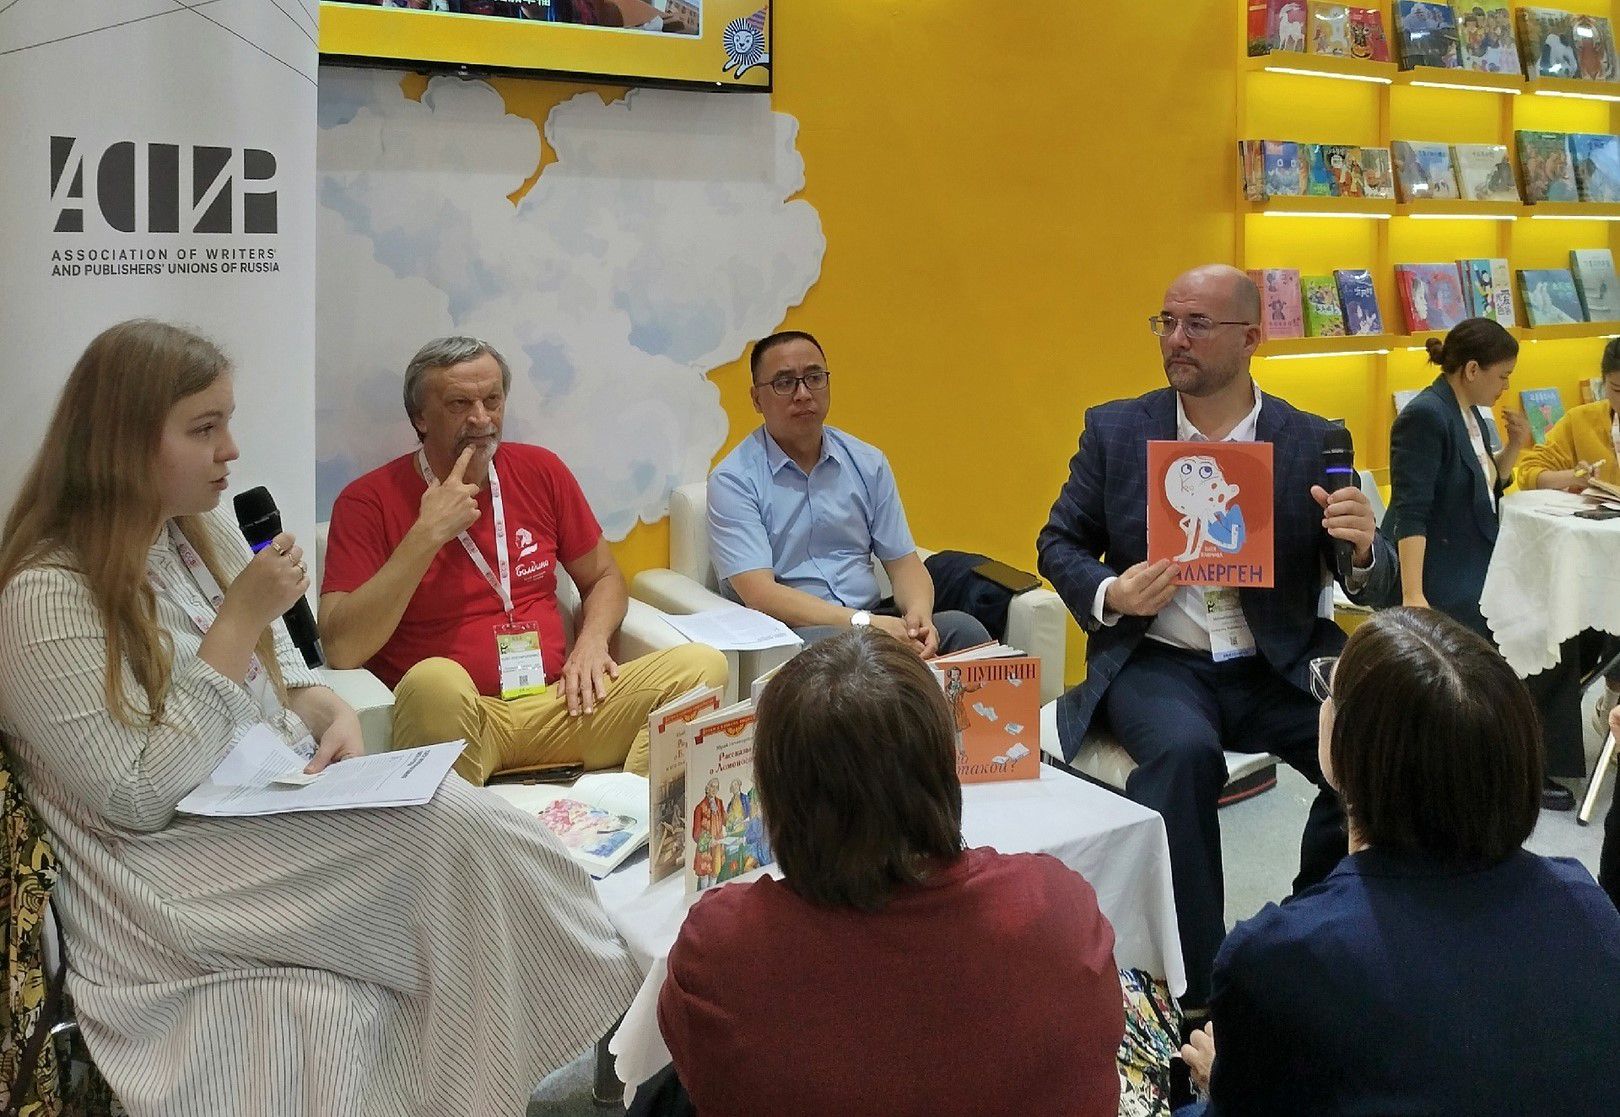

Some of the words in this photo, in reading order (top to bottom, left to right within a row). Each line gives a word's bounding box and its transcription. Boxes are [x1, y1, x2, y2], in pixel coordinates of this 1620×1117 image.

[52, 249, 168, 261] ASSOCIATION
[177, 249, 197, 260] OF
[52, 264, 81, 276] AND
[168, 262, 218, 274] UNIONS
[221, 262, 237, 273] OF
[240, 262, 280, 273] RUSSIA
[968, 664, 1035, 682] ПУШКИН
